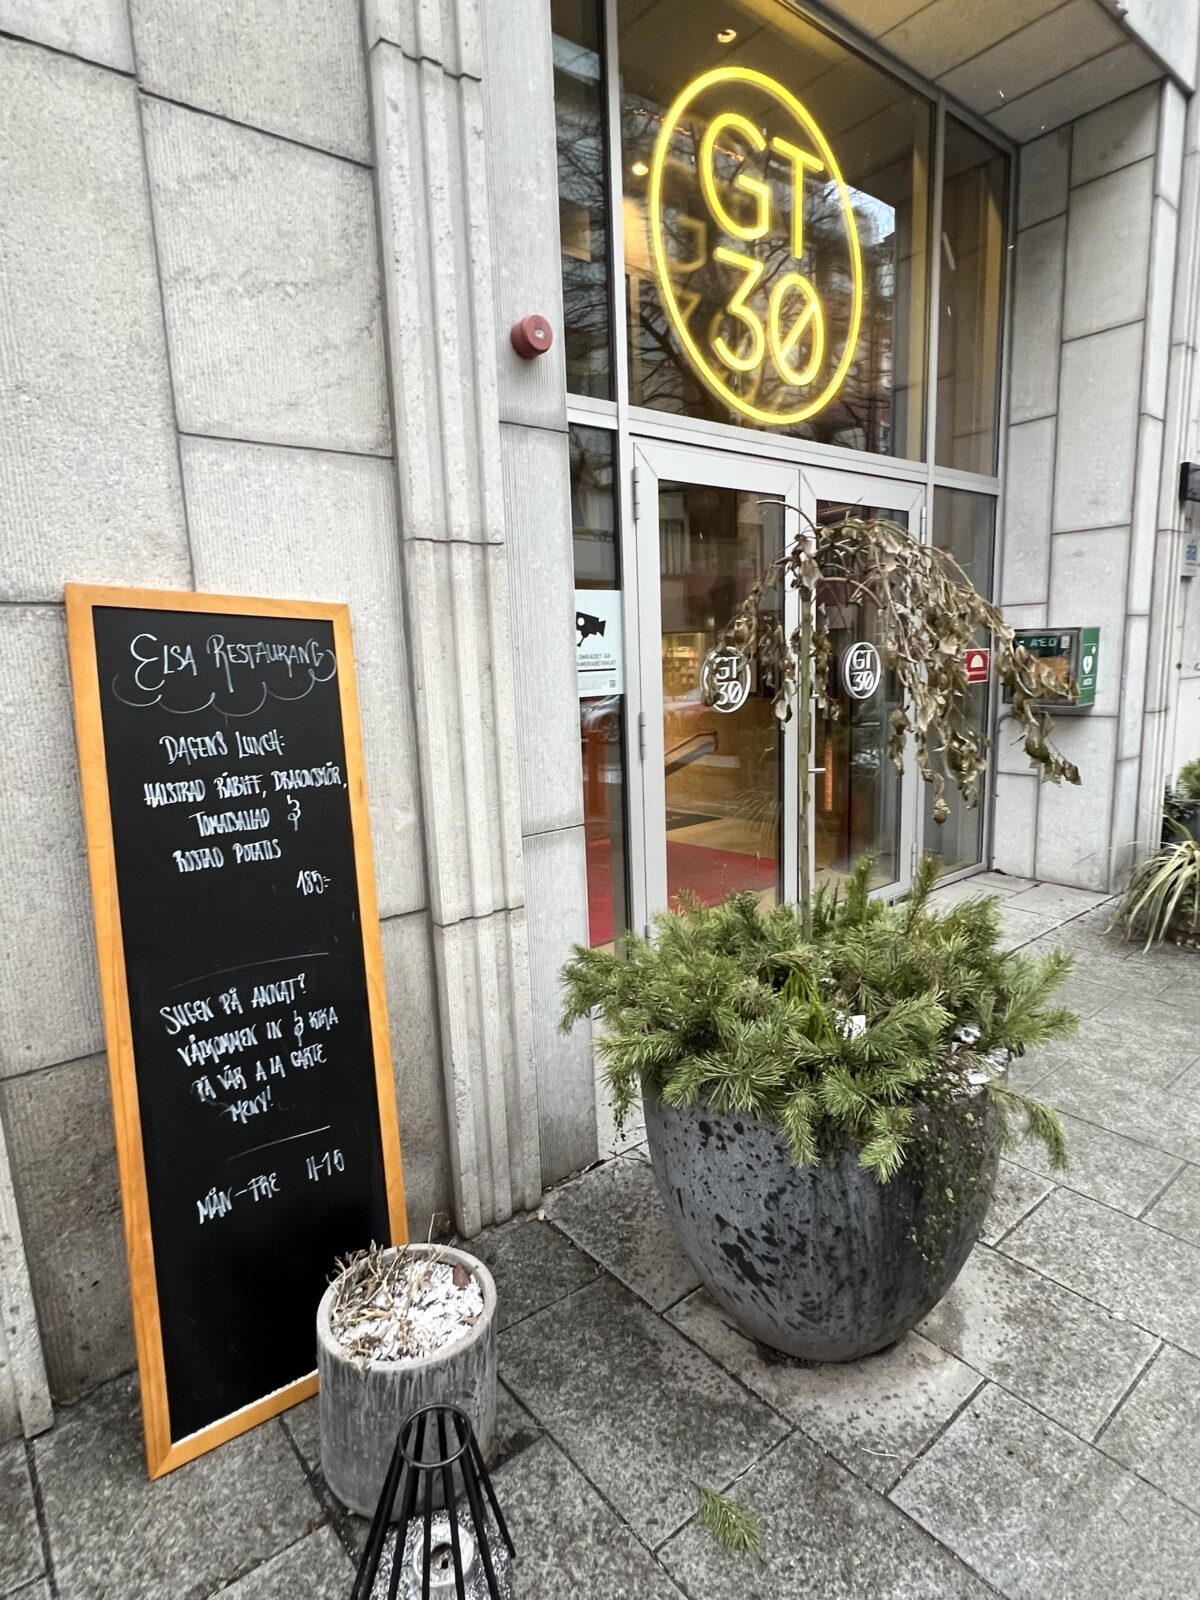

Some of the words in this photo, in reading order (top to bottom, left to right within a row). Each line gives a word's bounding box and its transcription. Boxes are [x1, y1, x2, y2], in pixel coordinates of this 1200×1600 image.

[702, 112, 825, 260] GT
[713, 246, 825, 387] 30
[1030, 637, 1058, 647] AED
[130, 633, 198, 691] ELSA
[206, 634, 327, 693] RESTAURANG
[852, 649, 875, 670] GT
[716, 680, 743, 705] 30
[850, 670, 874, 691] 30
[159, 730, 228, 765] DAGENS
[235, 728, 286, 759] LUNCH:
[143, 778, 206, 808] HALSTRAD
[188, 807, 271, 837] TOMATSALLAD
[172, 846, 225, 873] ROSTAD
[232, 838, 282, 864] POTATIS
[159, 996, 215, 1035] SUGEN
[218, 987, 244, 1015] PÅ
[250, 972, 307, 1009] ANNAT?
[265, 1018, 282, 1040] IN
[308, 1006, 340, 1031] KIKA
[194, 1075, 217, 1102] PÅ
[216, 1064, 248, 1091] VÅR
[255, 1060, 268, 1082] A
[269, 1055, 286, 1078] LA
[289, 1043, 328, 1070] CARTE
[305, 1148, 345, 1182] 11-15
